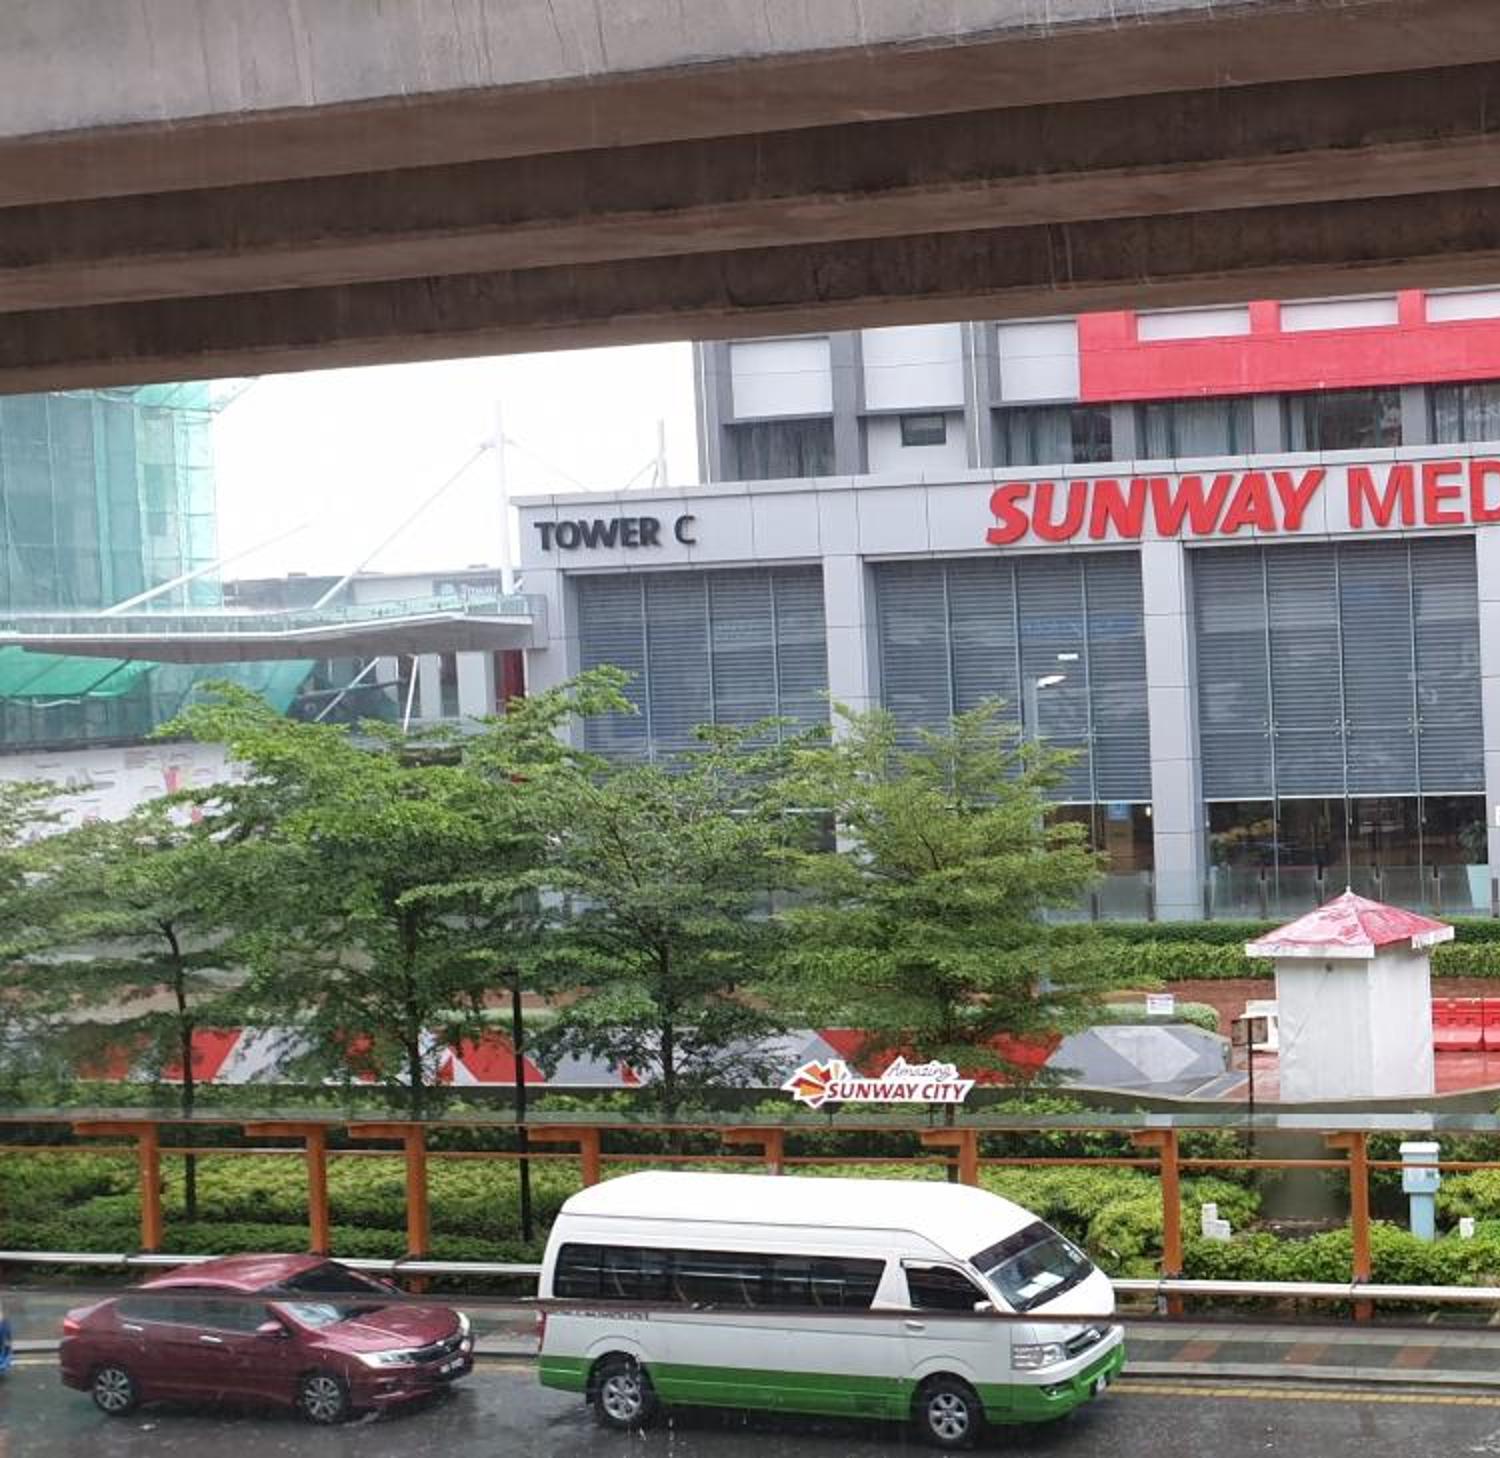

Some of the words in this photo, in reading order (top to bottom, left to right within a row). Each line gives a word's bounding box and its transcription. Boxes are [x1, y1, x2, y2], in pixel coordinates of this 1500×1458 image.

[987, 469, 1326, 546] SUNWAY
[533, 516, 663, 551] TOWER
[673, 514, 697, 545] C
[889, 1062, 953, 1081] Amazing
[827, 1082, 918, 1099] SUNWAY
[921, 1082, 966, 1099] CITY
